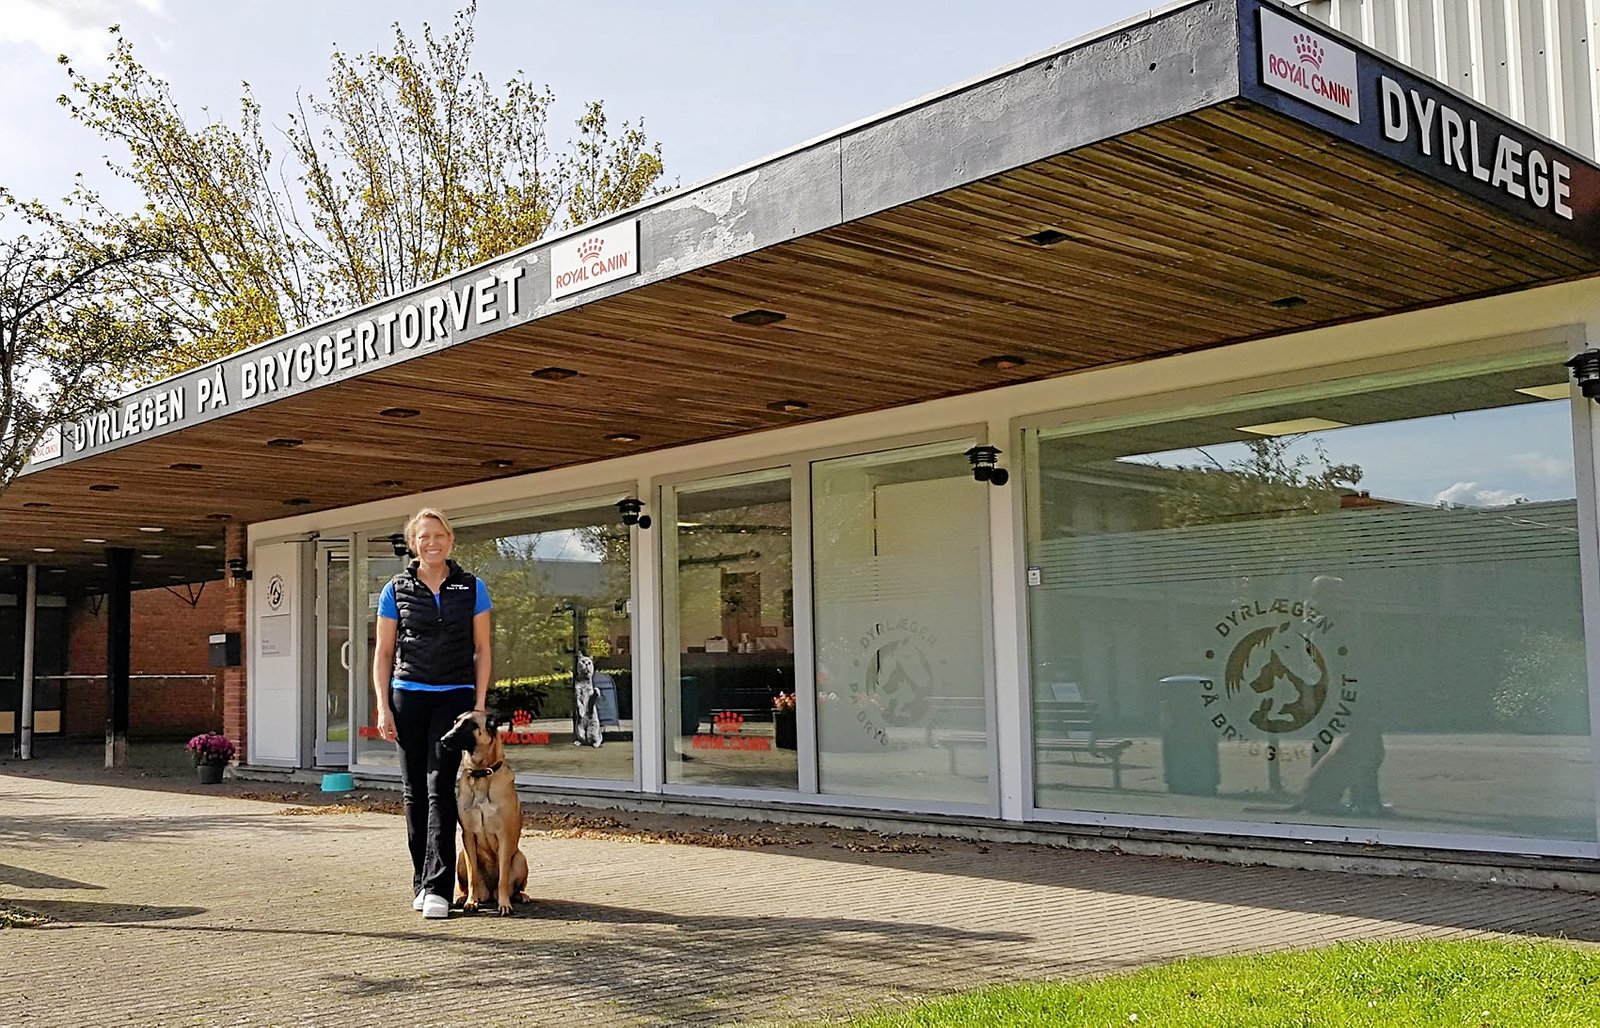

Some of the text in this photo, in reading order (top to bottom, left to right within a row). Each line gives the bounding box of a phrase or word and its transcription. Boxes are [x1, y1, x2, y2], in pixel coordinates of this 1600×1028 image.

[1269, 53, 1350, 108] ROYAL CANIN
[1381, 74, 1573, 220] DYRLÆGE
[556, 251, 628, 289] ROYAL CANIN
[74, 266, 525, 452] DYRLÆGEN PÅ BRYGGERTORVET
[1215, 598, 1334, 638] DYRLÆGEN
[1199, 679, 1220, 708] PÅ
